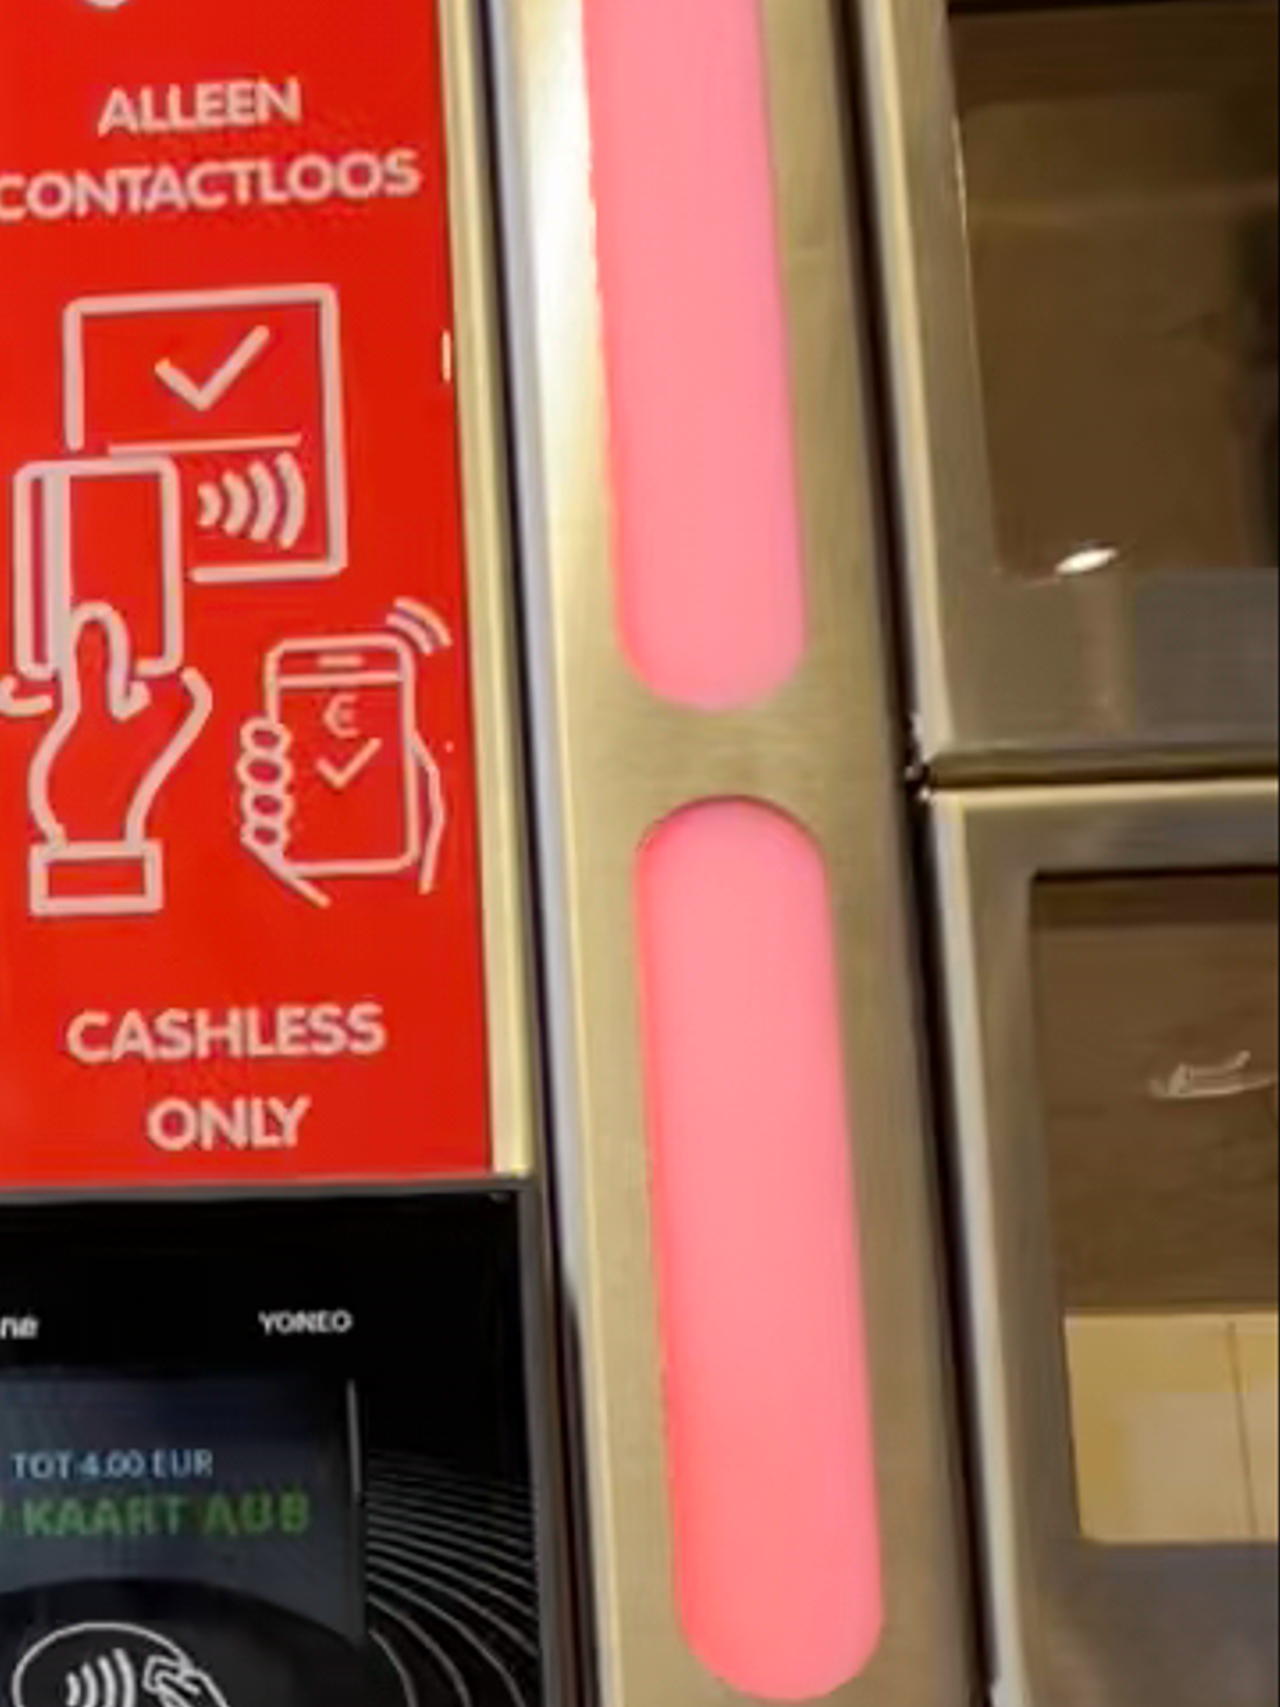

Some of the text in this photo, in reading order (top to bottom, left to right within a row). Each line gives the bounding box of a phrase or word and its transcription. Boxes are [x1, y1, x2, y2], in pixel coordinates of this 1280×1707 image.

[97, 78, 302, 136] ALLEEN
[66, 1002, 386, 1063] CASHLESS
[147, 1097, 311, 1151] ONLY
[12, 1452, 71, 1479] TOT
[152, 1449, 212, 1477] EUR
[22, 1496, 186, 1535] KAART
